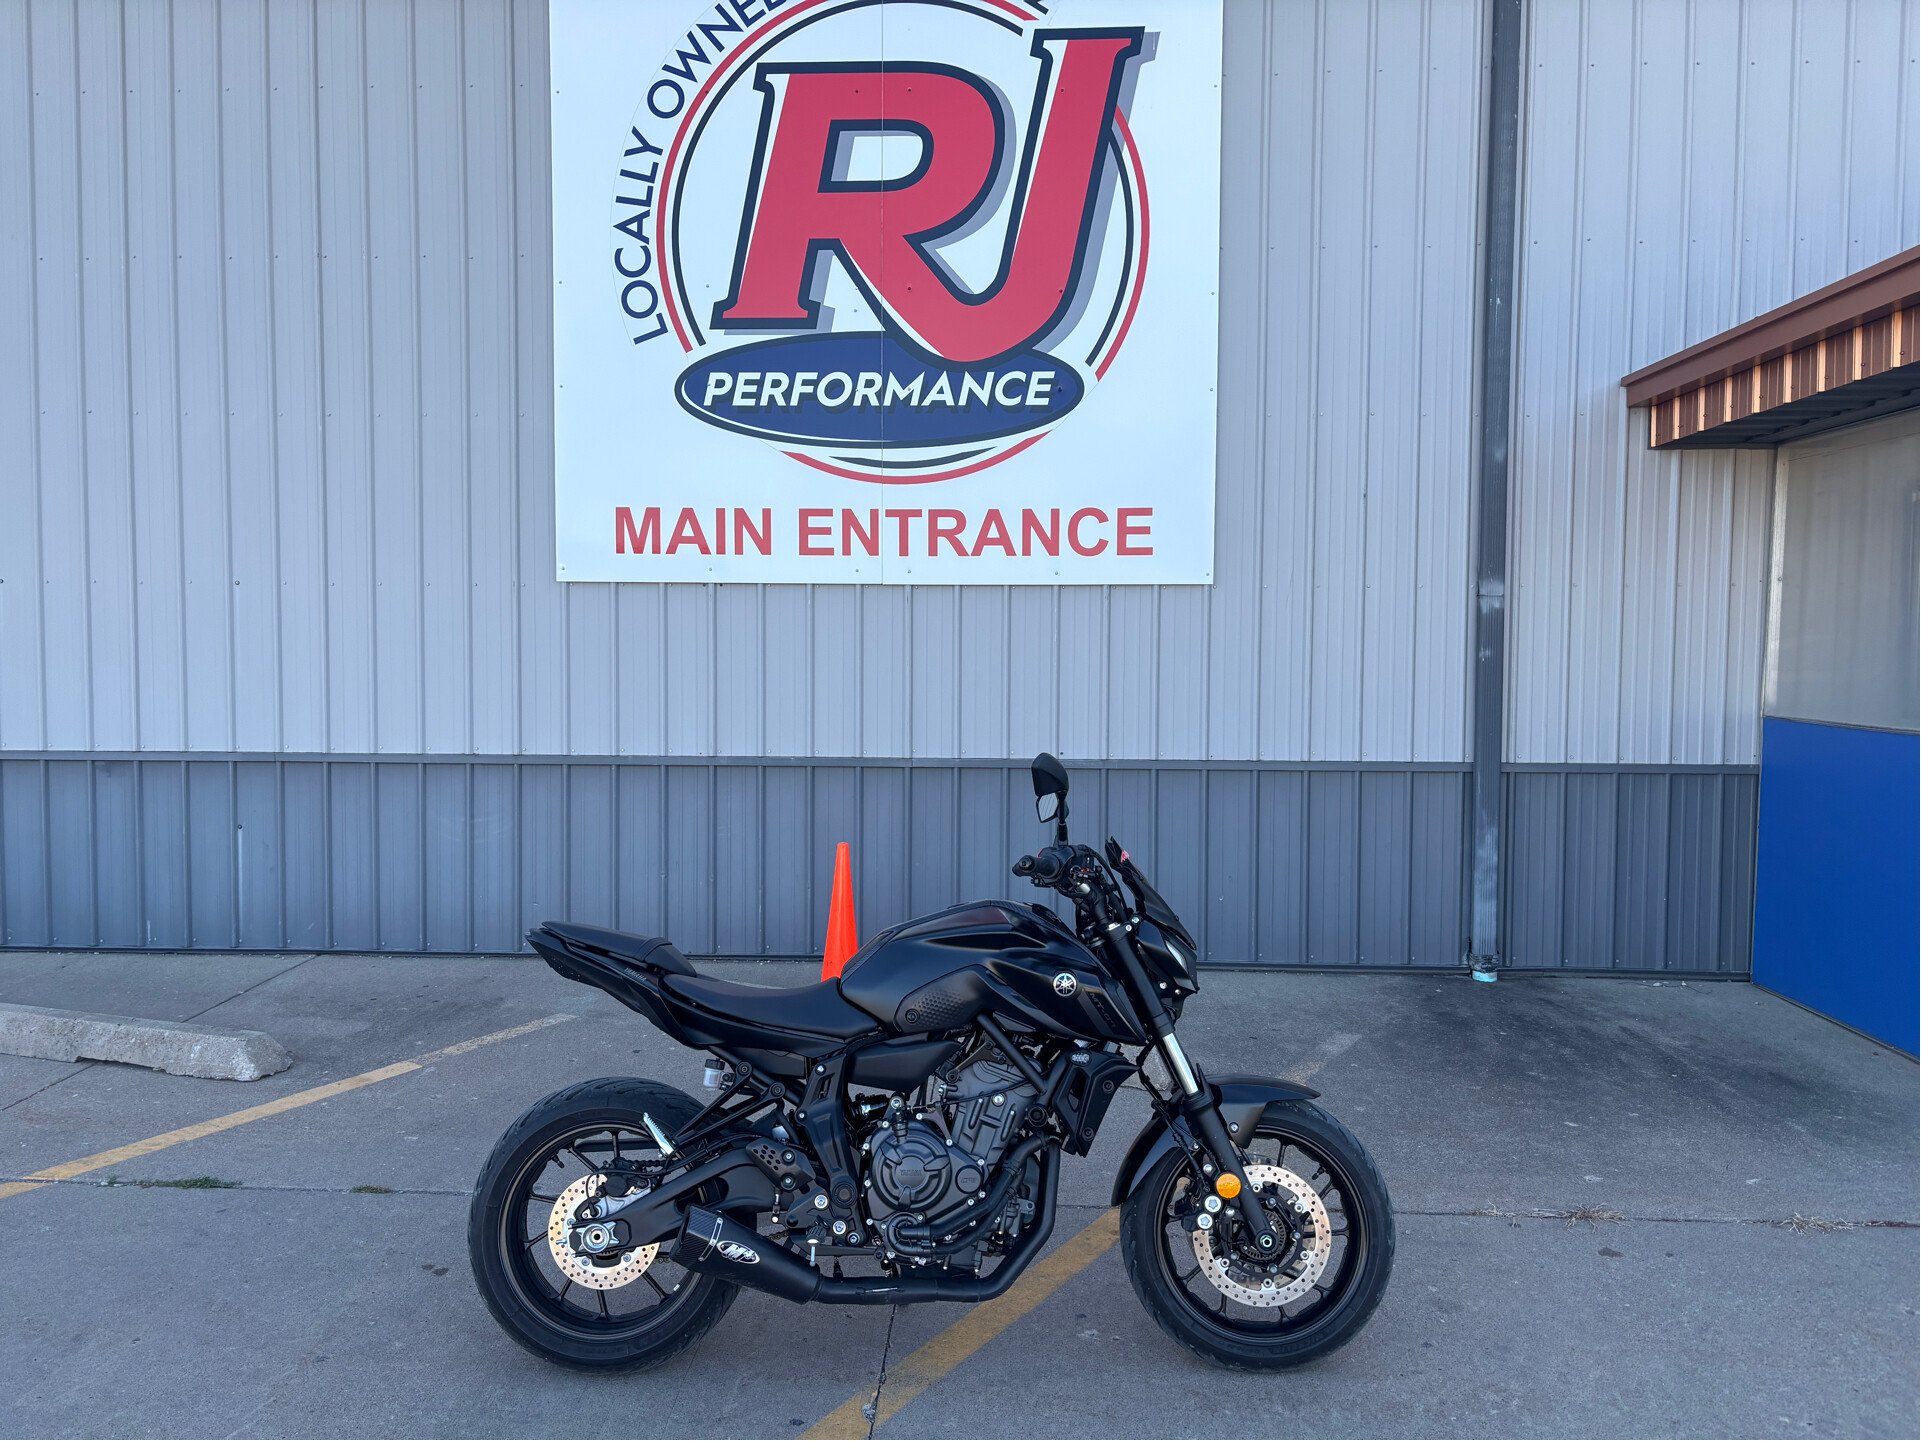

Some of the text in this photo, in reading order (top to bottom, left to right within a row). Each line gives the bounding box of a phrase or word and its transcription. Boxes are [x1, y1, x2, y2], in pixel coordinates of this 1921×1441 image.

[613, 127, 669, 345] LOCALLY
[709, 26, 1146, 365] RJ
[703, 371, 1055, 407] PERFORMANCE
[614, 507, 1154, 557] MAIN ENTRANCE
